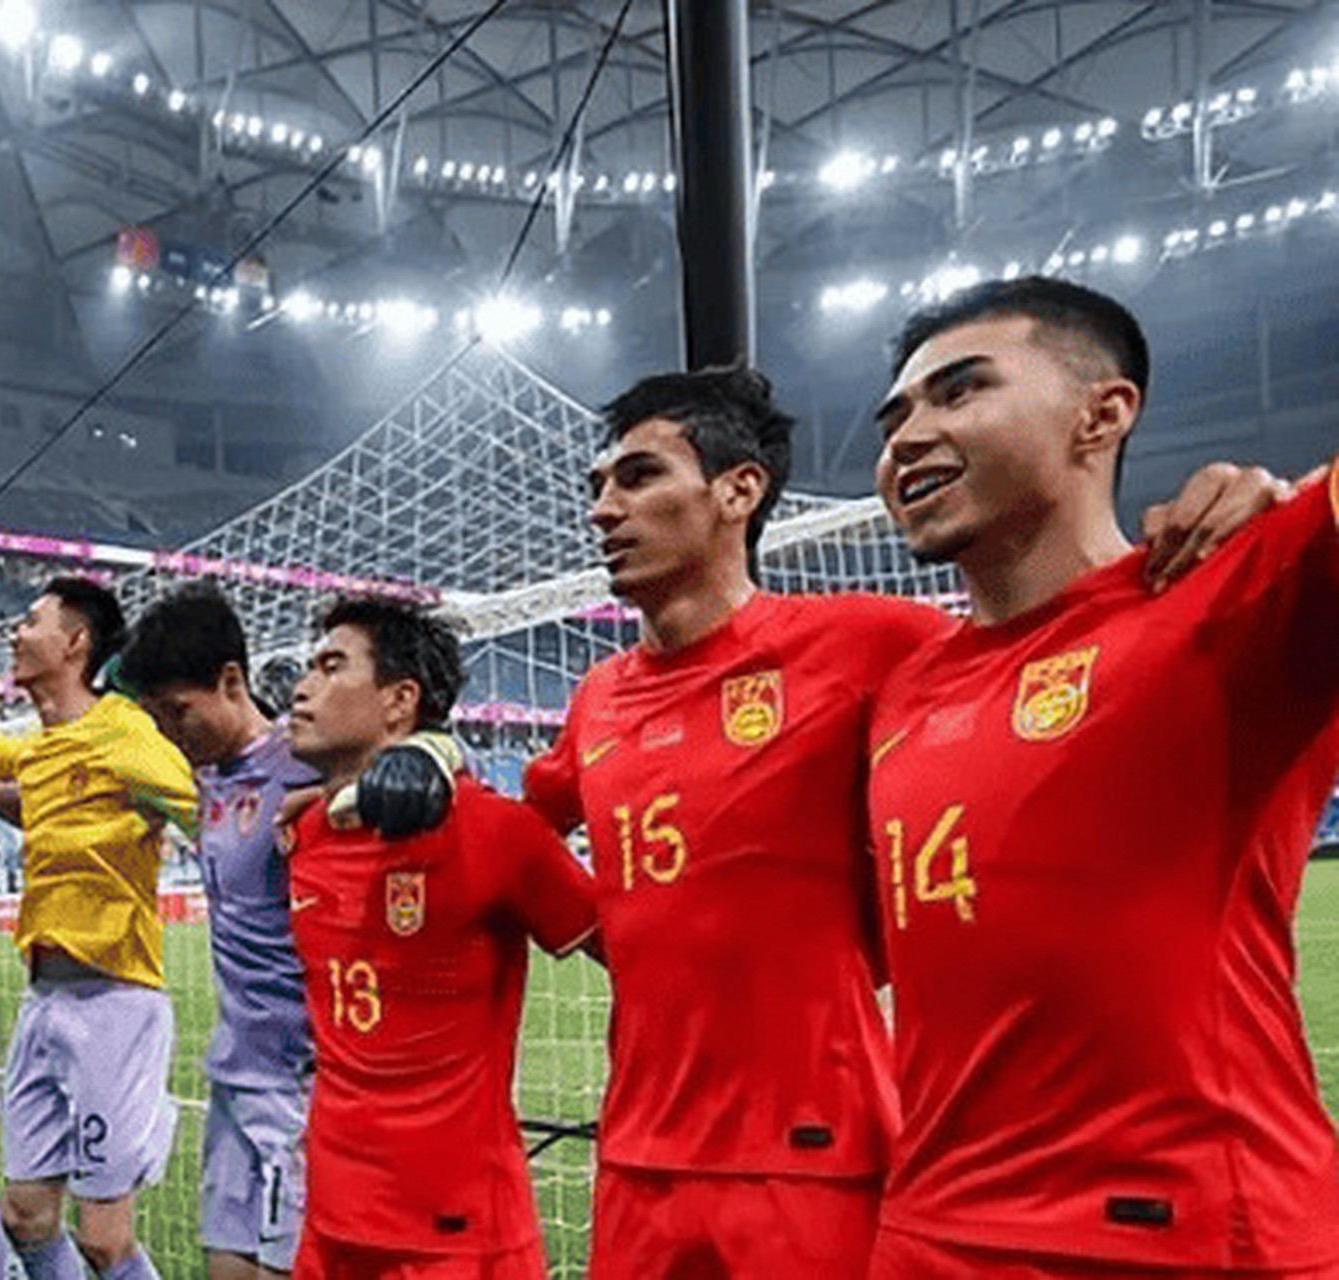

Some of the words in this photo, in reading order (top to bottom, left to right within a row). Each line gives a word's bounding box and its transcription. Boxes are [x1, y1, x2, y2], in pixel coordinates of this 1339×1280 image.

[614, 793, 685, 891] 15
[886, 804, 976, 929] 14
[329, 959, 380, 1033] 13
[73, 1113, 108, 1163] 12
